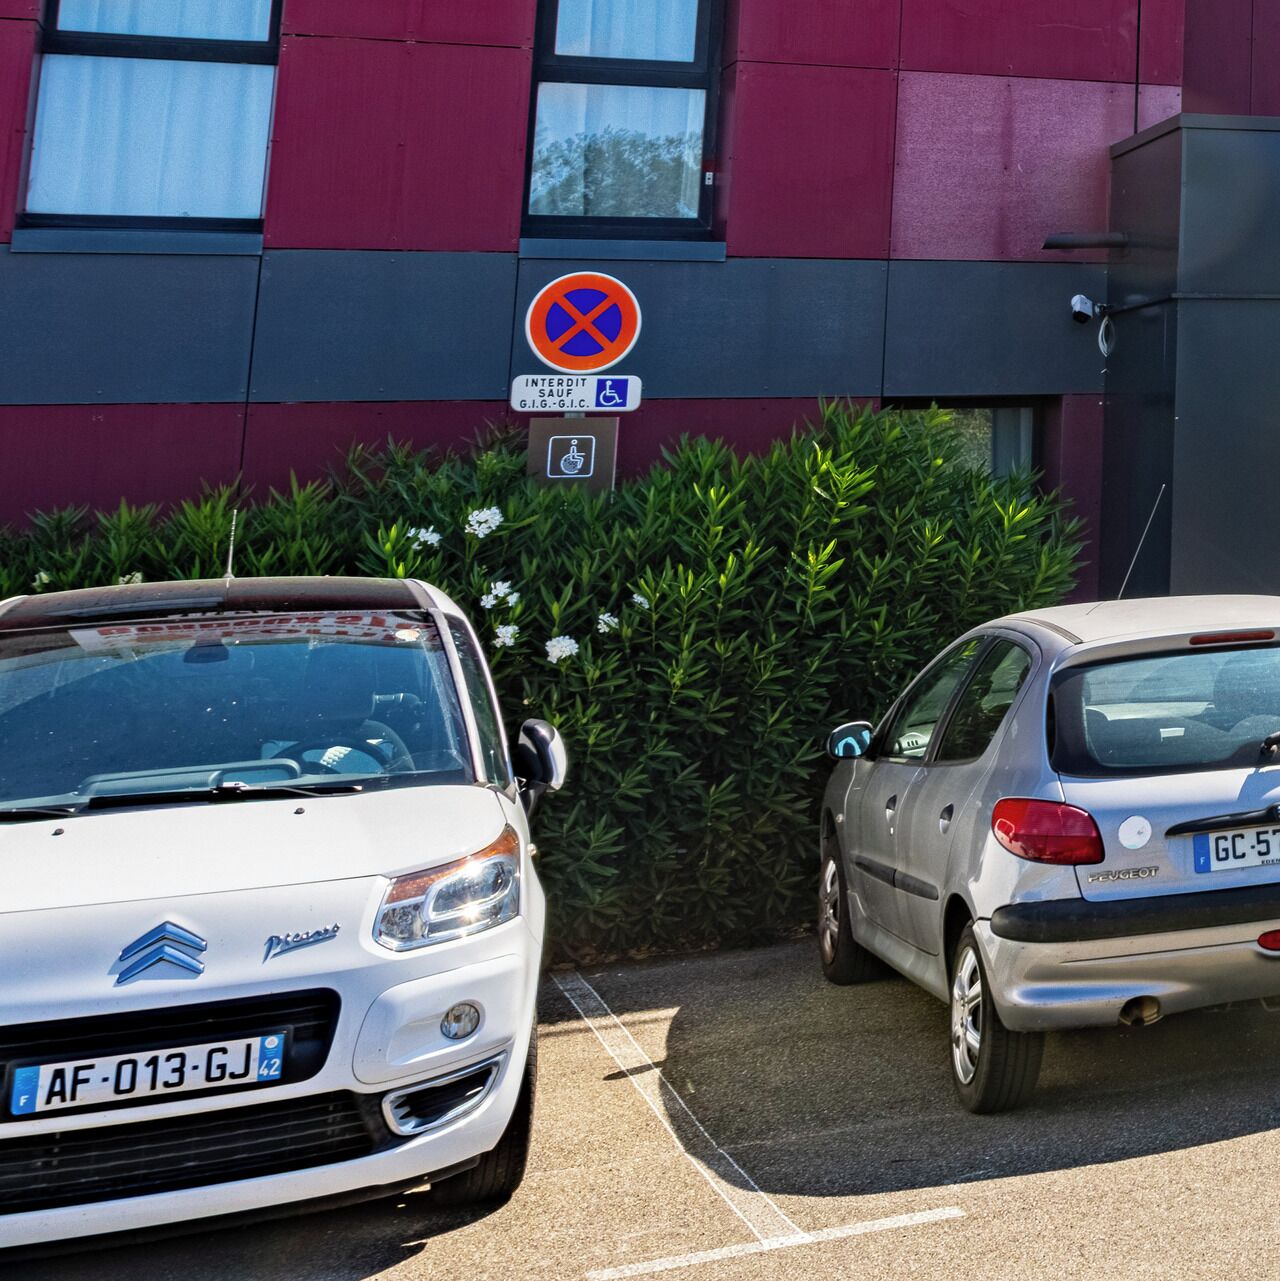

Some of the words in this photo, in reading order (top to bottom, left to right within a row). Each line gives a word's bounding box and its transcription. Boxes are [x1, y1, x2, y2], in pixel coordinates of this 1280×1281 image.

[525, 378, 588, 388] INTERDIT
[538, 389, 574, 398] SAUF
[1088, 866, 1160, 883] PEUGEOT
[44, 1042, 253, 1106] AF-013-GJ
[258, 1058, 281, 1076] 42
[18, 1094, 30, 1107] F
